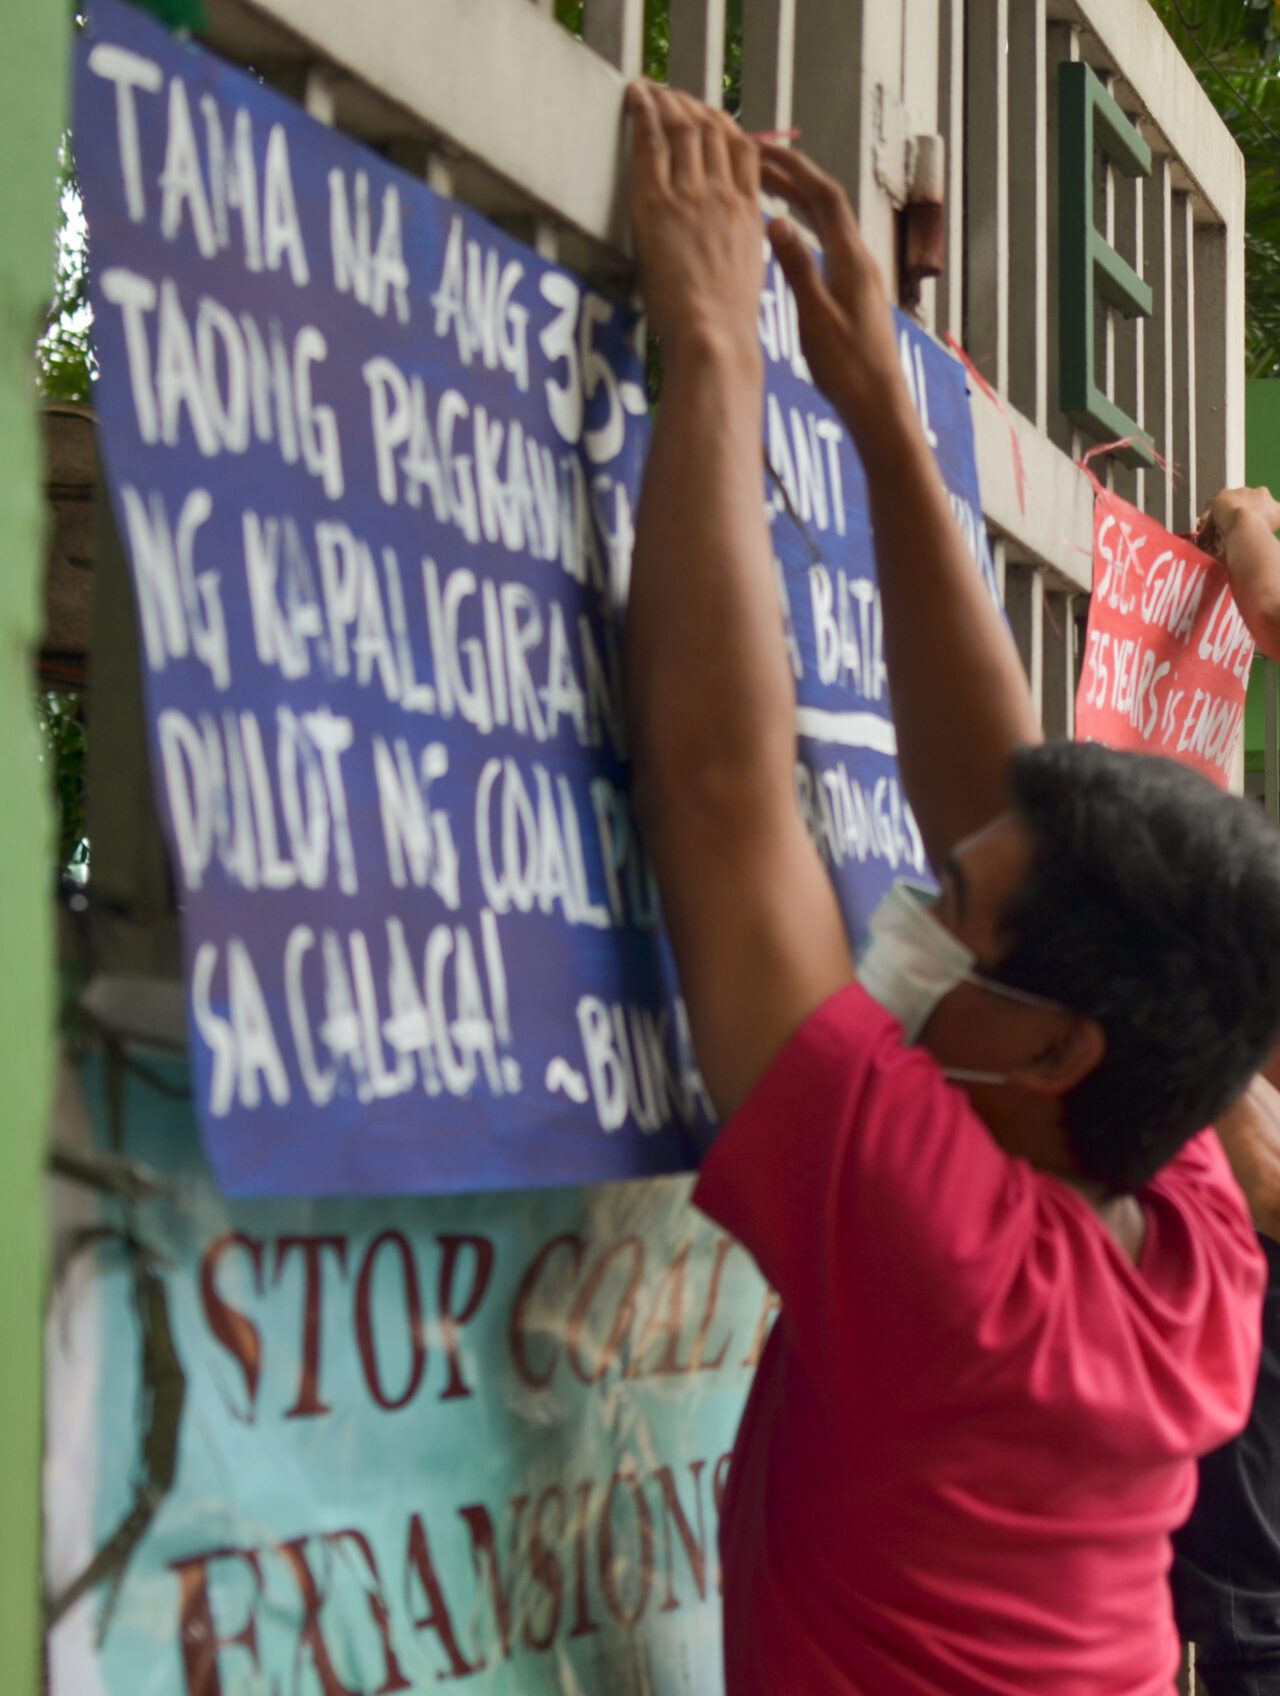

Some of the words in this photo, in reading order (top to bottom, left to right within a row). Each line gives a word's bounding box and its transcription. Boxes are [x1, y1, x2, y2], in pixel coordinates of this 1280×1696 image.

[89, 44, 309, 287] TAMA
[330, 168, 410, 324] NA
[431, 215, 530, 392] ANG
[765, 394, 846, 538] ANT
[120, 483, 232, 692] NG
[1140, 549, 1209, 647] GINA
[1085, 629, 1111, 709] 35
[1110, 636, 1172, 741] YEARS
[159, 704, 359, 897] DULOT
[475, 756, 612, 930] COAL
[191, 939, 292, 1119] SA
[200, 1230, 495, 1427] STOP
[510, 1233, 736, 1393] COAL
